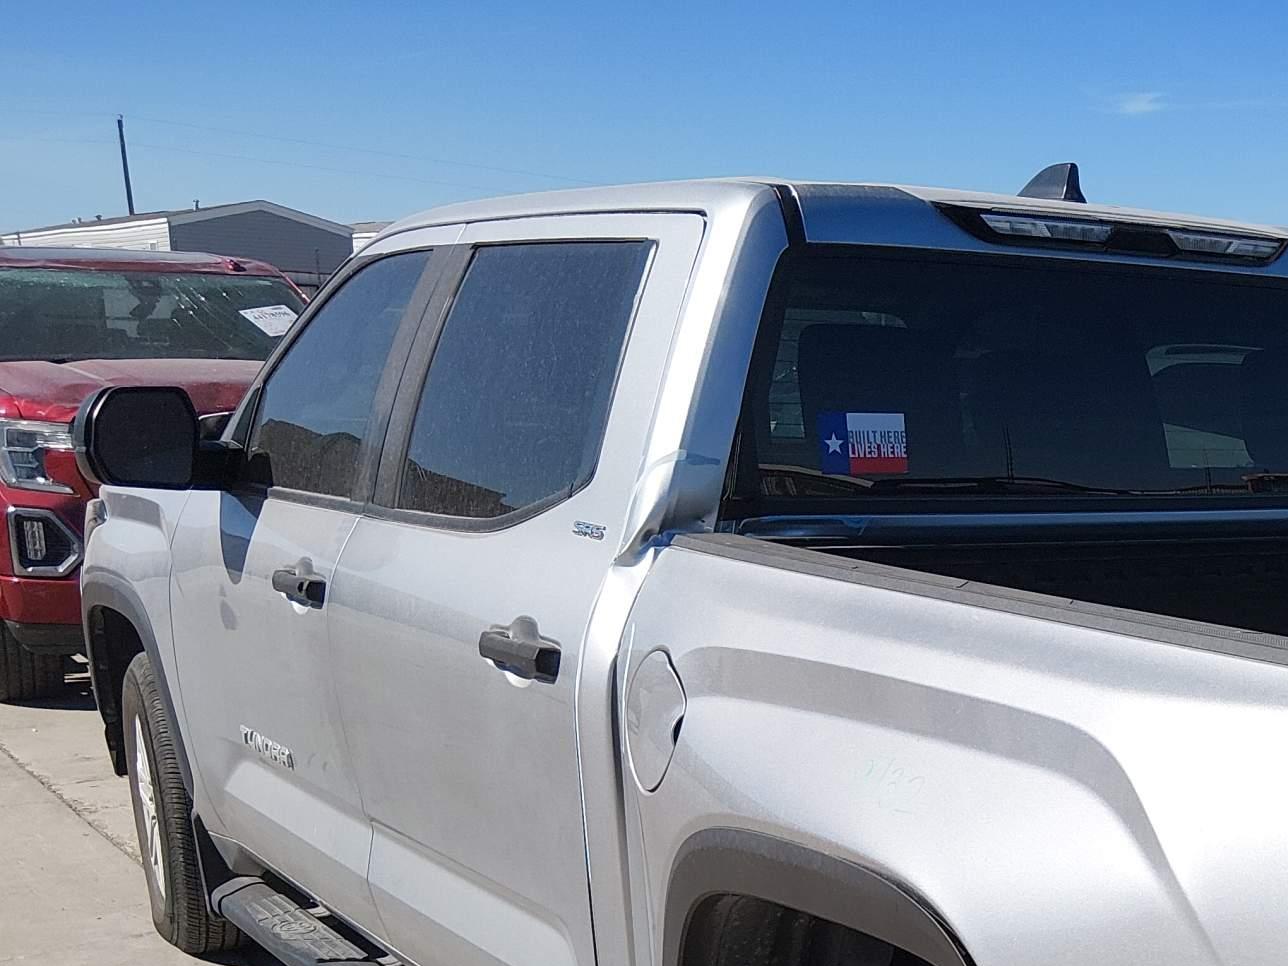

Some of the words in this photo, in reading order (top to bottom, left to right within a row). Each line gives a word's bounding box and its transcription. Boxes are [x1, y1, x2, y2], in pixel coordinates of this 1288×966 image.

[848, 430, 878, 445] BUILT
[880, 430, 907, 445] HERE
[848, 444, 878, 458] LIVES
[880, 444, 908, 458] HERE
[240, 724, 296, 771] TUNDRA
